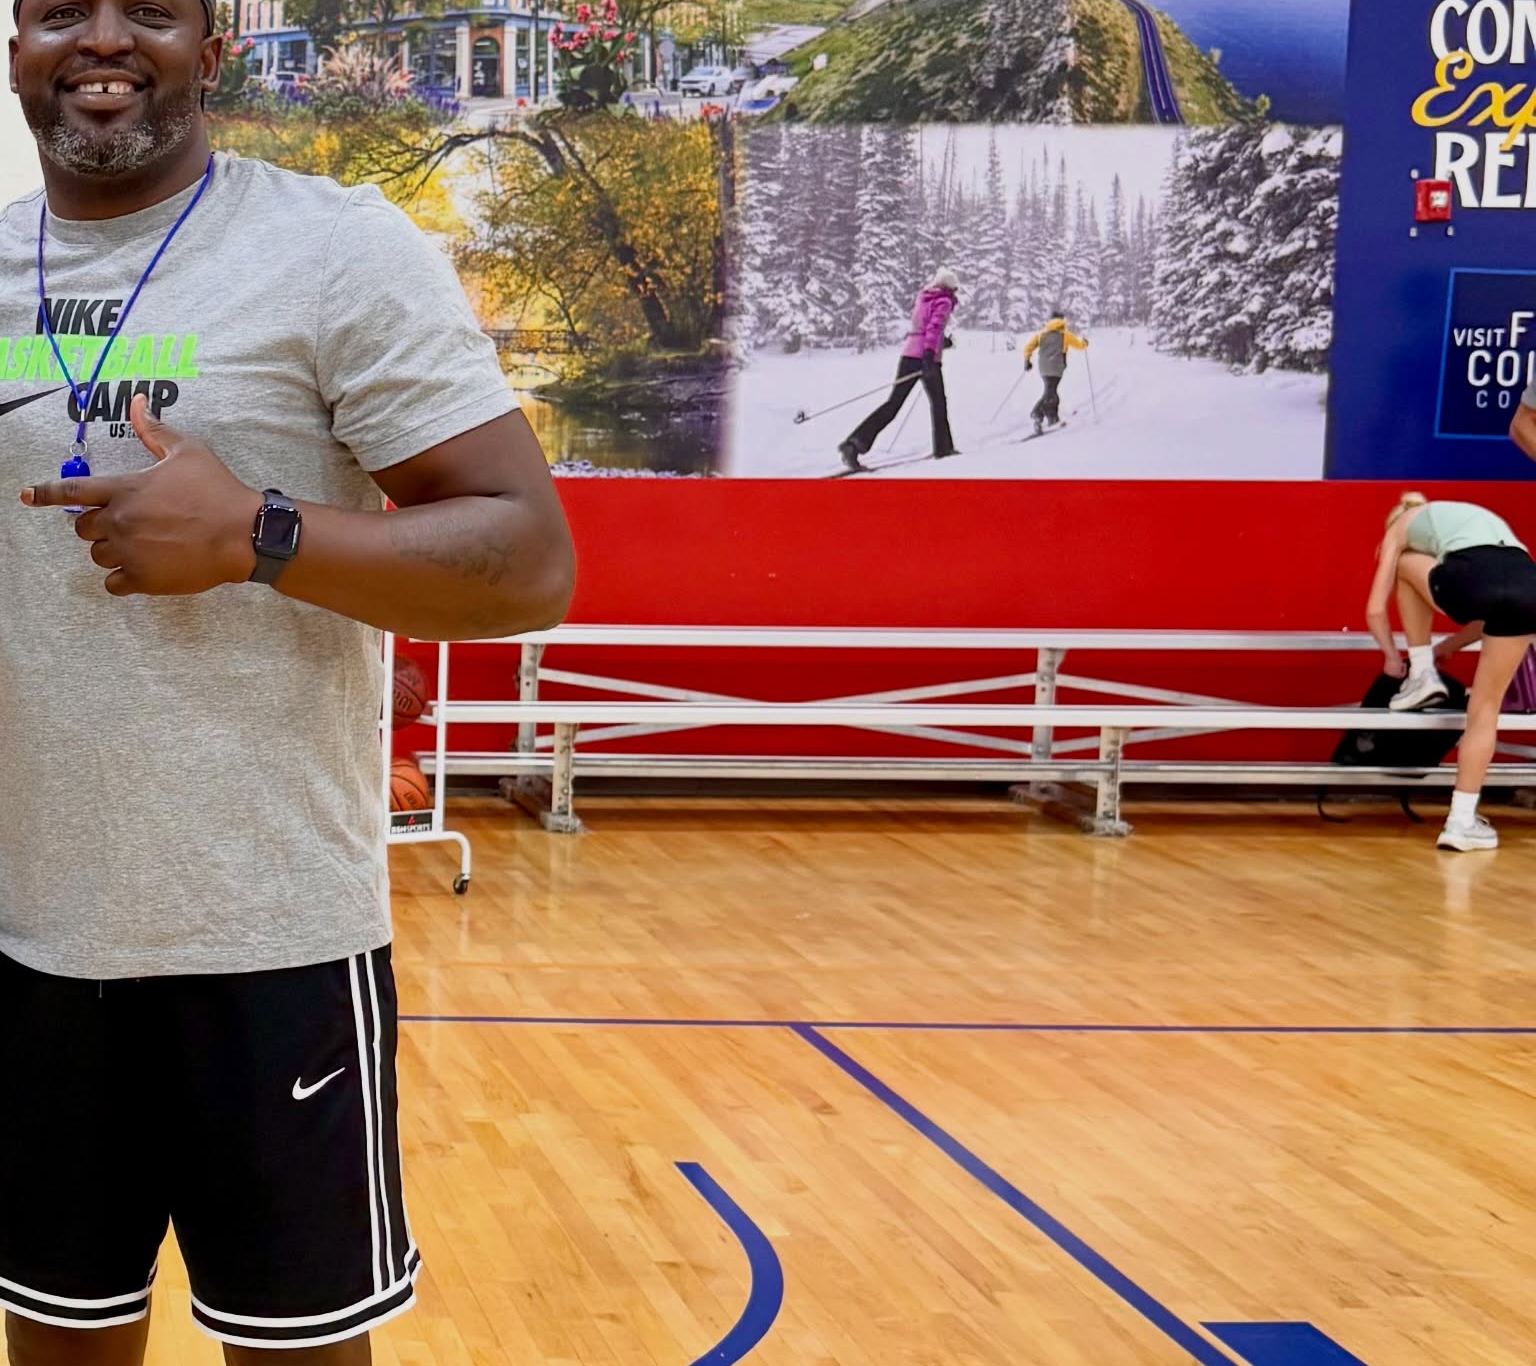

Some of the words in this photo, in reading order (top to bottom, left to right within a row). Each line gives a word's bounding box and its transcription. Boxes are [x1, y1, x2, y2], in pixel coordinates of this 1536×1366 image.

[35, 297, 124, 335] NIKE
[1453, 327, 1506, 347] VISIT
[66, 379, 180, 424] CAMP
